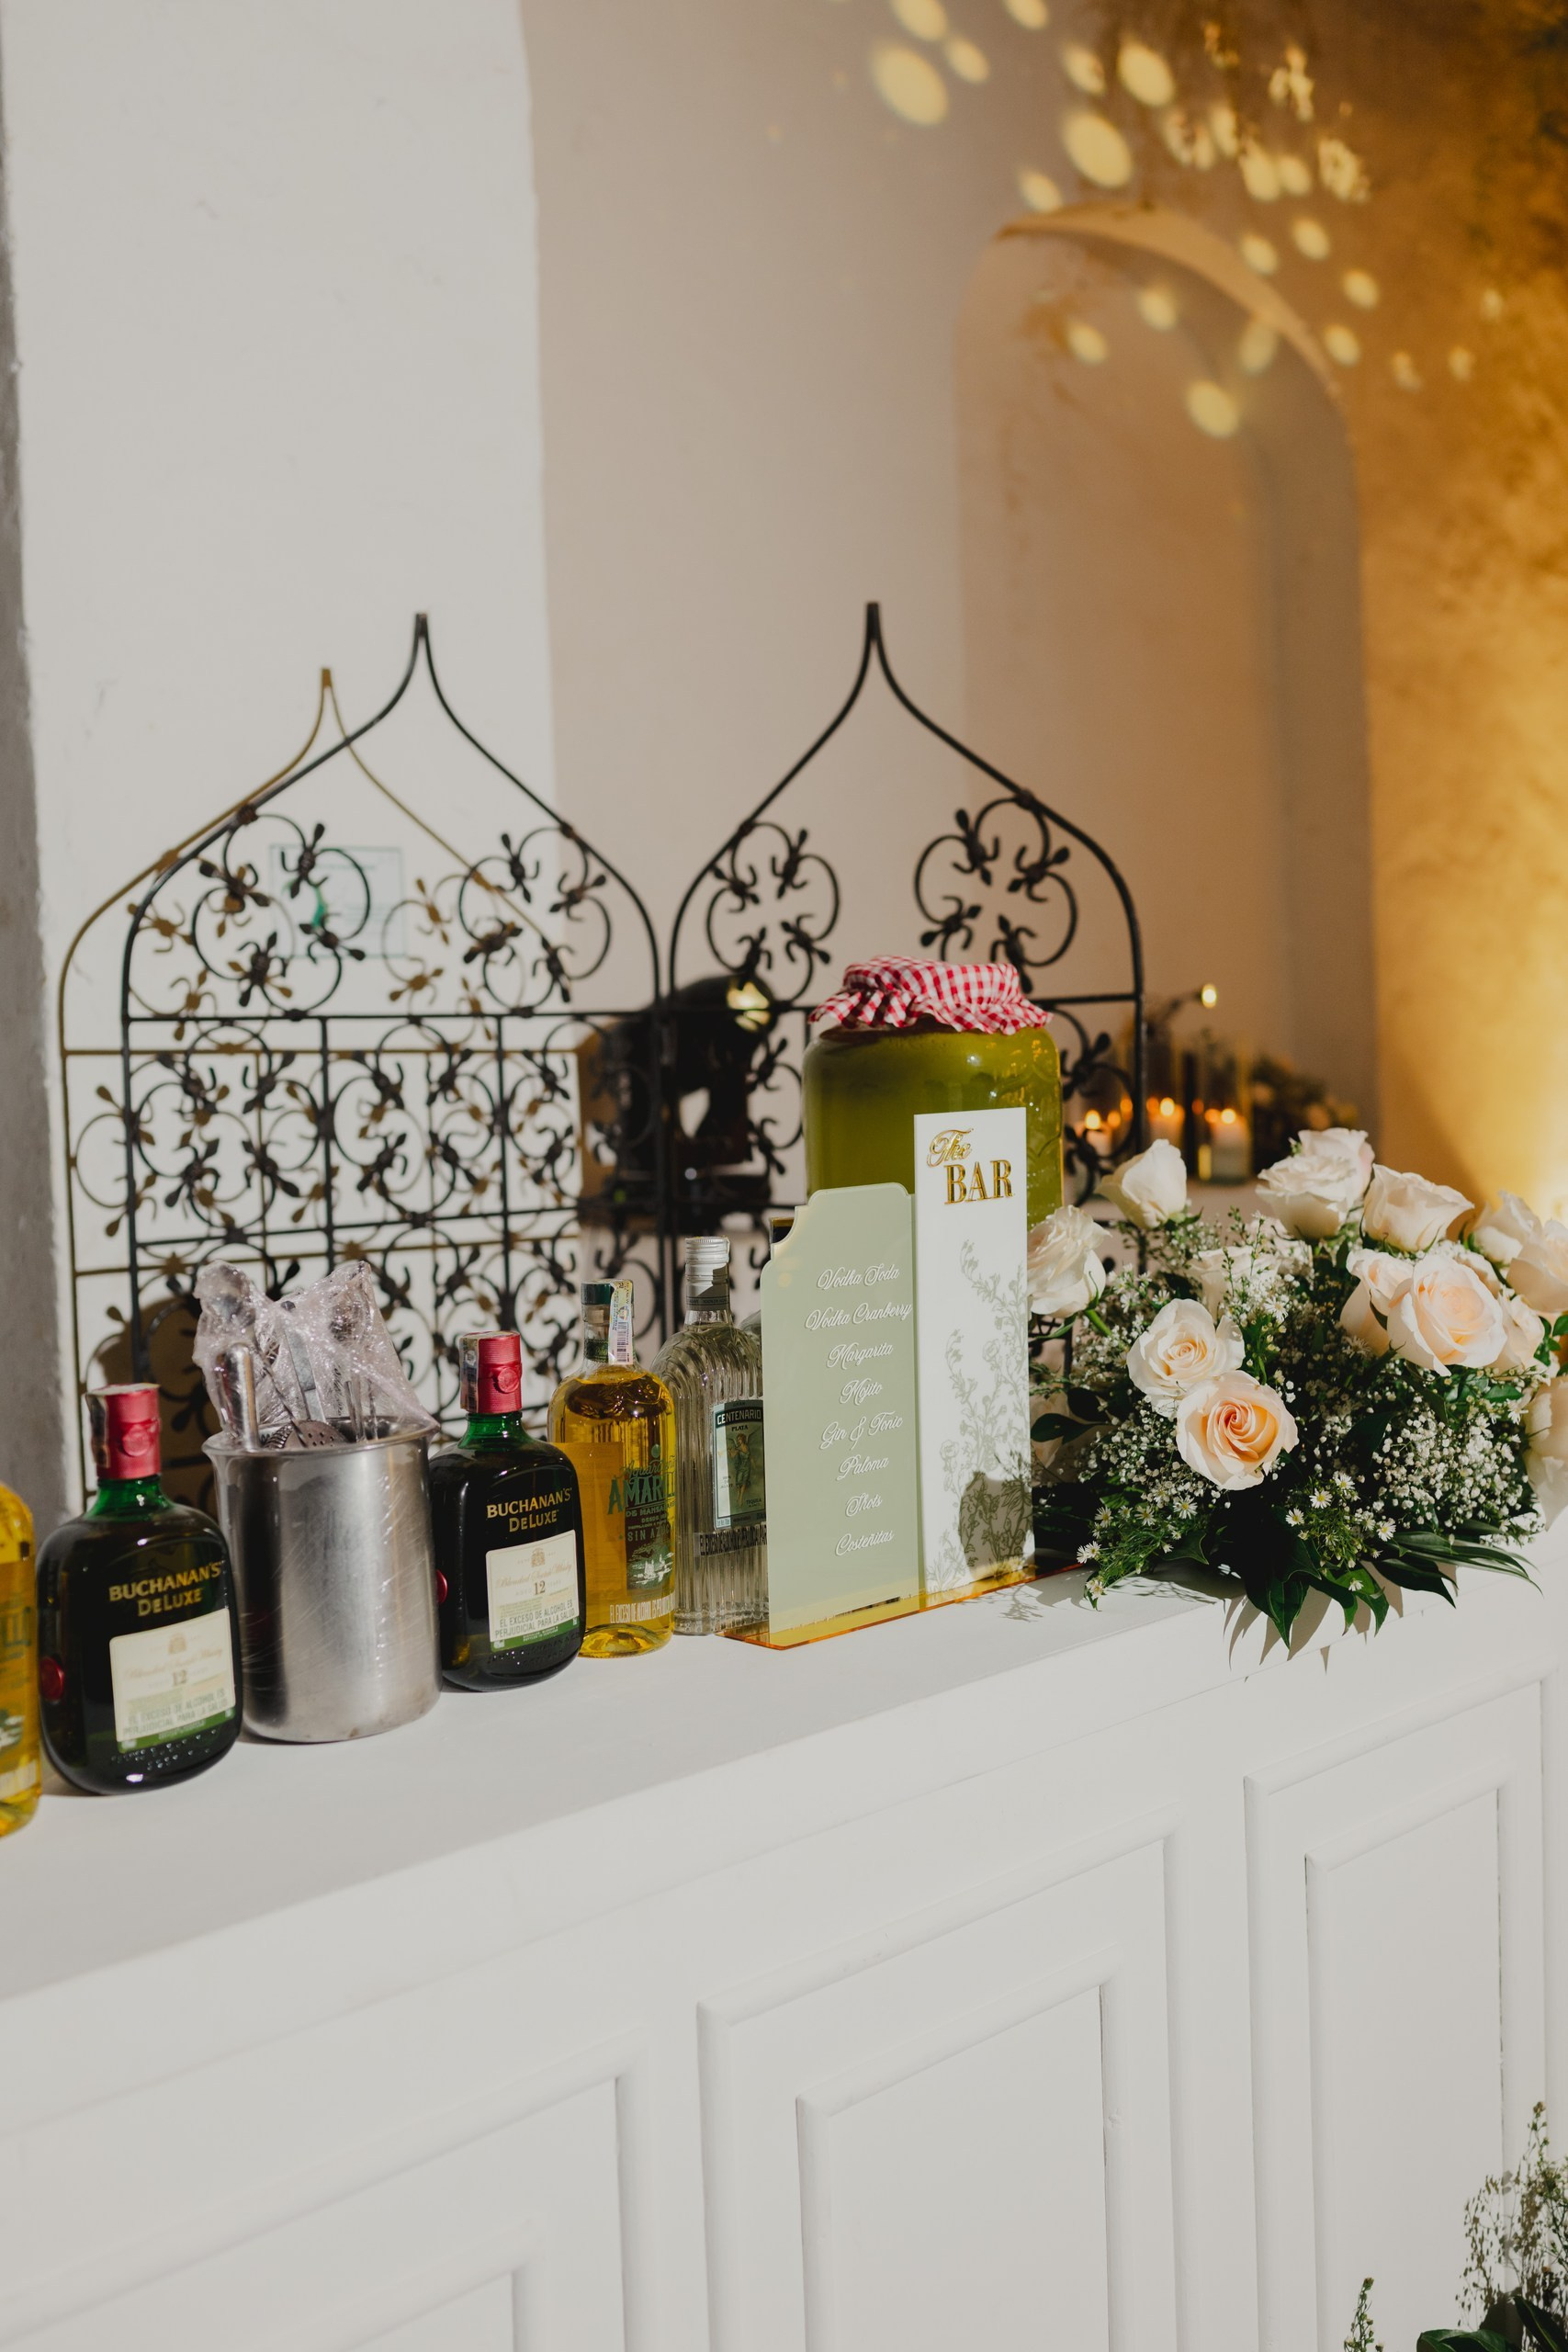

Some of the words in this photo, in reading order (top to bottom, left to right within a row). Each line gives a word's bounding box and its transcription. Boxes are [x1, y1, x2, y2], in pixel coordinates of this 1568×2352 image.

[926, 1128, 974, 1168] The
[943, 1159, 1014, 1204] BAR
[817, 1267, 862, 1290] Vodka
[863, 1263, 899, 1286] Soda
[805, 1307, 851, 1330] Vodka
[852, 1302, 912, 1325] Cranberry
[827, 1342, 894, 1370] Margarita
[840, 1378, 883, 1405] Mojito
[716, 1409, 761, 1425] CENTENARIO
[819, 1421, 847, 1450] Gin
[849, 1417, 866, 1451] &
[867, 1411, 903, 1436] Tonic
[836, 1454, 889, 1481] Paloma
[486, 1487, 571, 1519] BUCHANAN'S
[845, 1492, 883, 1517] Shots
[627, 1530, 646, 1542] SIN
[835, 1530, 895, 1555] Costeñitas
[108, 1561, 221, 1601] BUCHANAN'S
[534, 1580, 546, 1595] 12
[495, 1623, 536, 1639] PERJUDICIAL
[537, 1617, 552, 1628] PARA
[552, 1613, 560, 1623] LA
[560, 1608, 575, 1620] SALUD
[500, 1618, 508, 1628] EL
[510, 1612, 534, 1625] EXCESO
[535, 1609, 544, 1619] DE
[544, 1601, 567, 1616] ALCOHOL
[567, 1599, 573, 1609] ES
